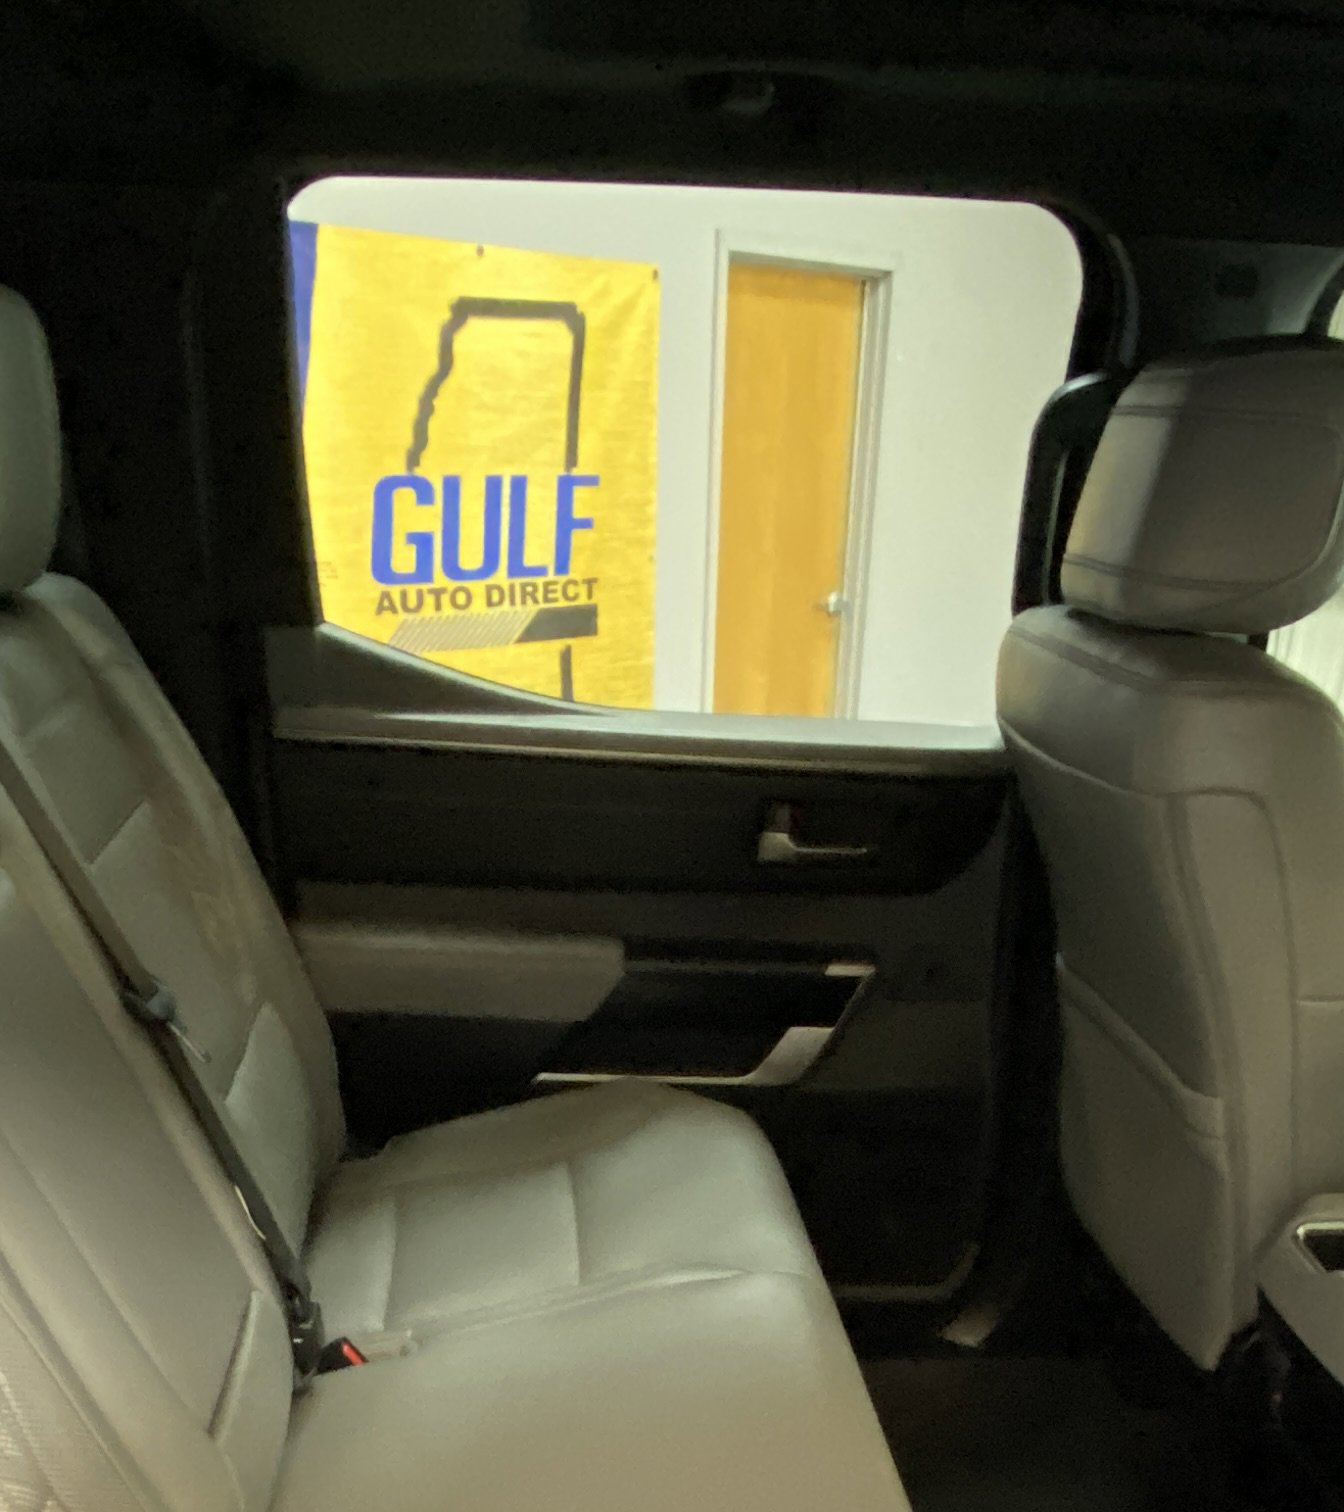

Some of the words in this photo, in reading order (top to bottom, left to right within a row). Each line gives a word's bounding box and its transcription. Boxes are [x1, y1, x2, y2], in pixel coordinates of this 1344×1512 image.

[371, 475, 600, 585] GULF
[375, 586, 473, 616] AUTO
[485, 578, 599, 608] DIRECT
